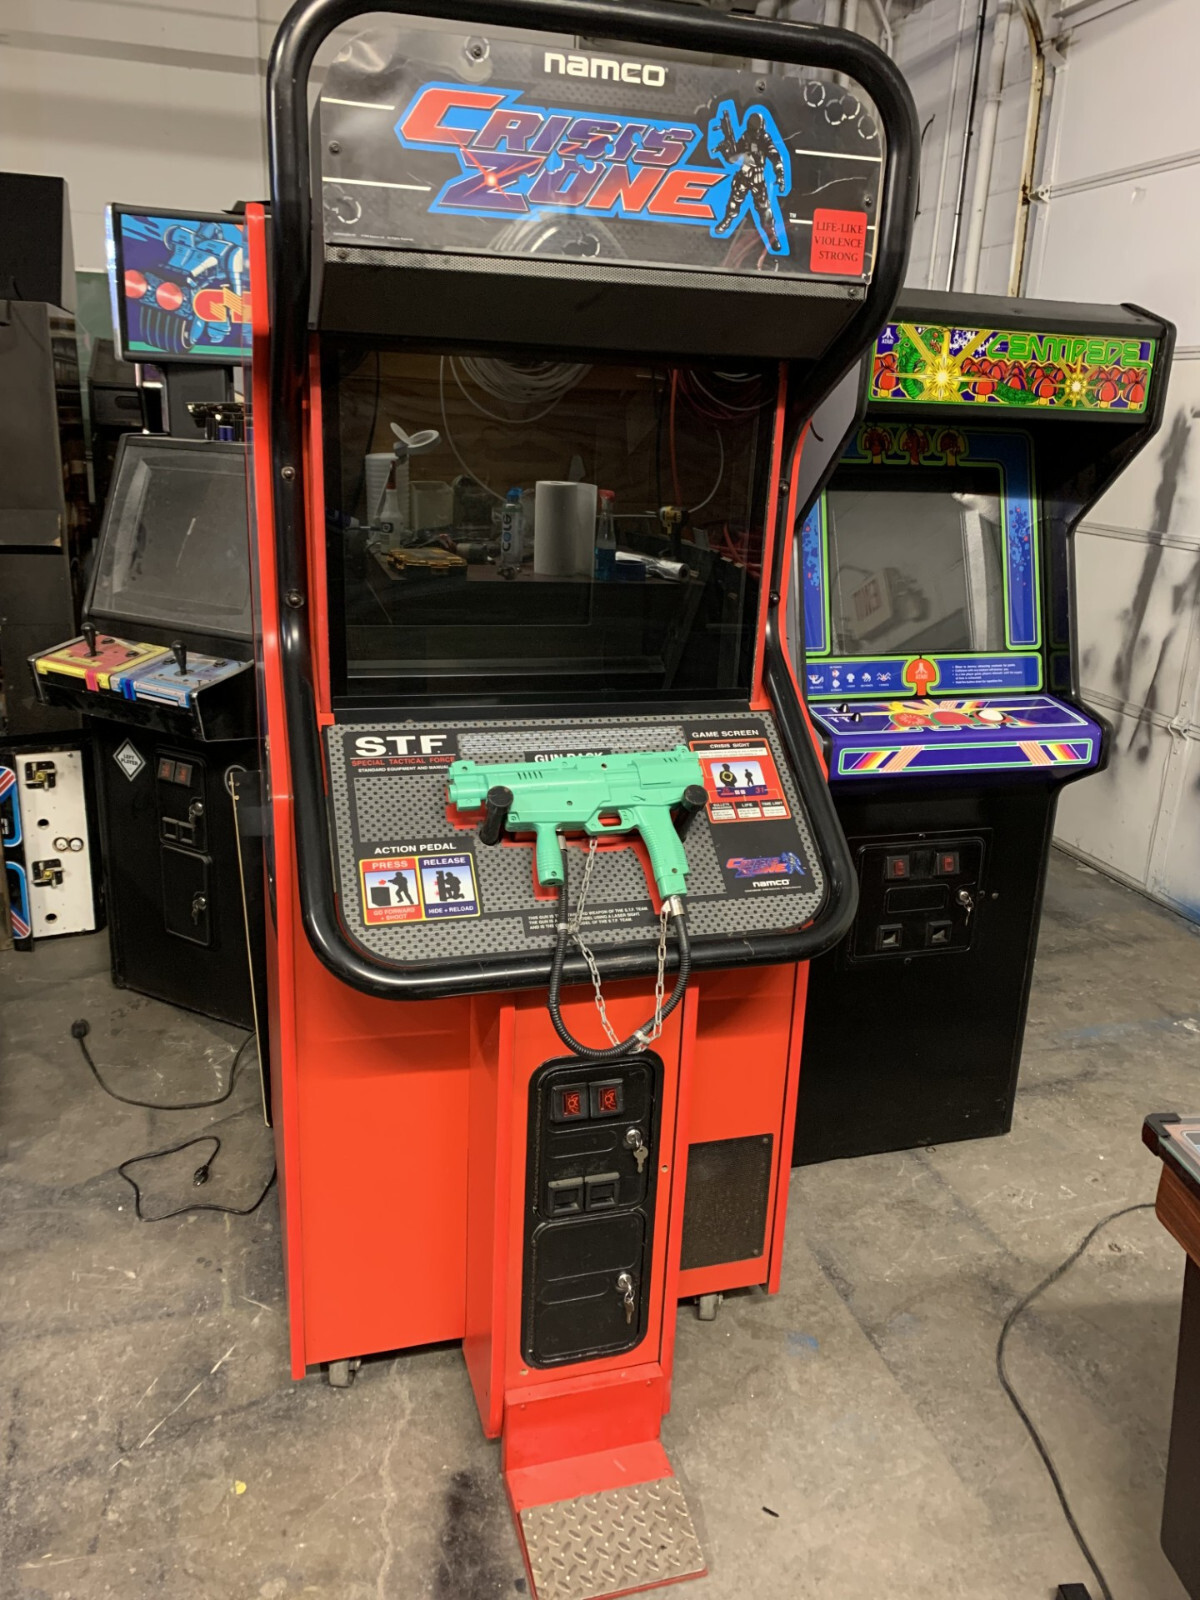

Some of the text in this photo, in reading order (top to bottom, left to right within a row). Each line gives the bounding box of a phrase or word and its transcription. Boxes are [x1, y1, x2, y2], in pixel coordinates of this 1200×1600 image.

[544, 52, 666, 87] namco
[400, 87, 695, 166] CRISIS
[437, 148, 727, 219] ZONE
[815, 221, 864, 234] LIFE-LIKE
[814, 235, 864, 248] VIOLENCE
[819, 250, 859, 262] STRONG
[986, 333, 1141, 368] CENTIPEDE
[691, 729, 759, 739] GAME SCREEN
[351, 759, 386, 767] SPECIAL
[388, 757, 427, 765] TACTICAL
[374, 842, 457, 855] ACTION PEDAL
[371, 856, 466, 869] PRESS RELEASE
[752, 879, 790, 888] namco
[384, 907, 415, 915] FORWARD
[449, 905, 474, 913] RELOAD
